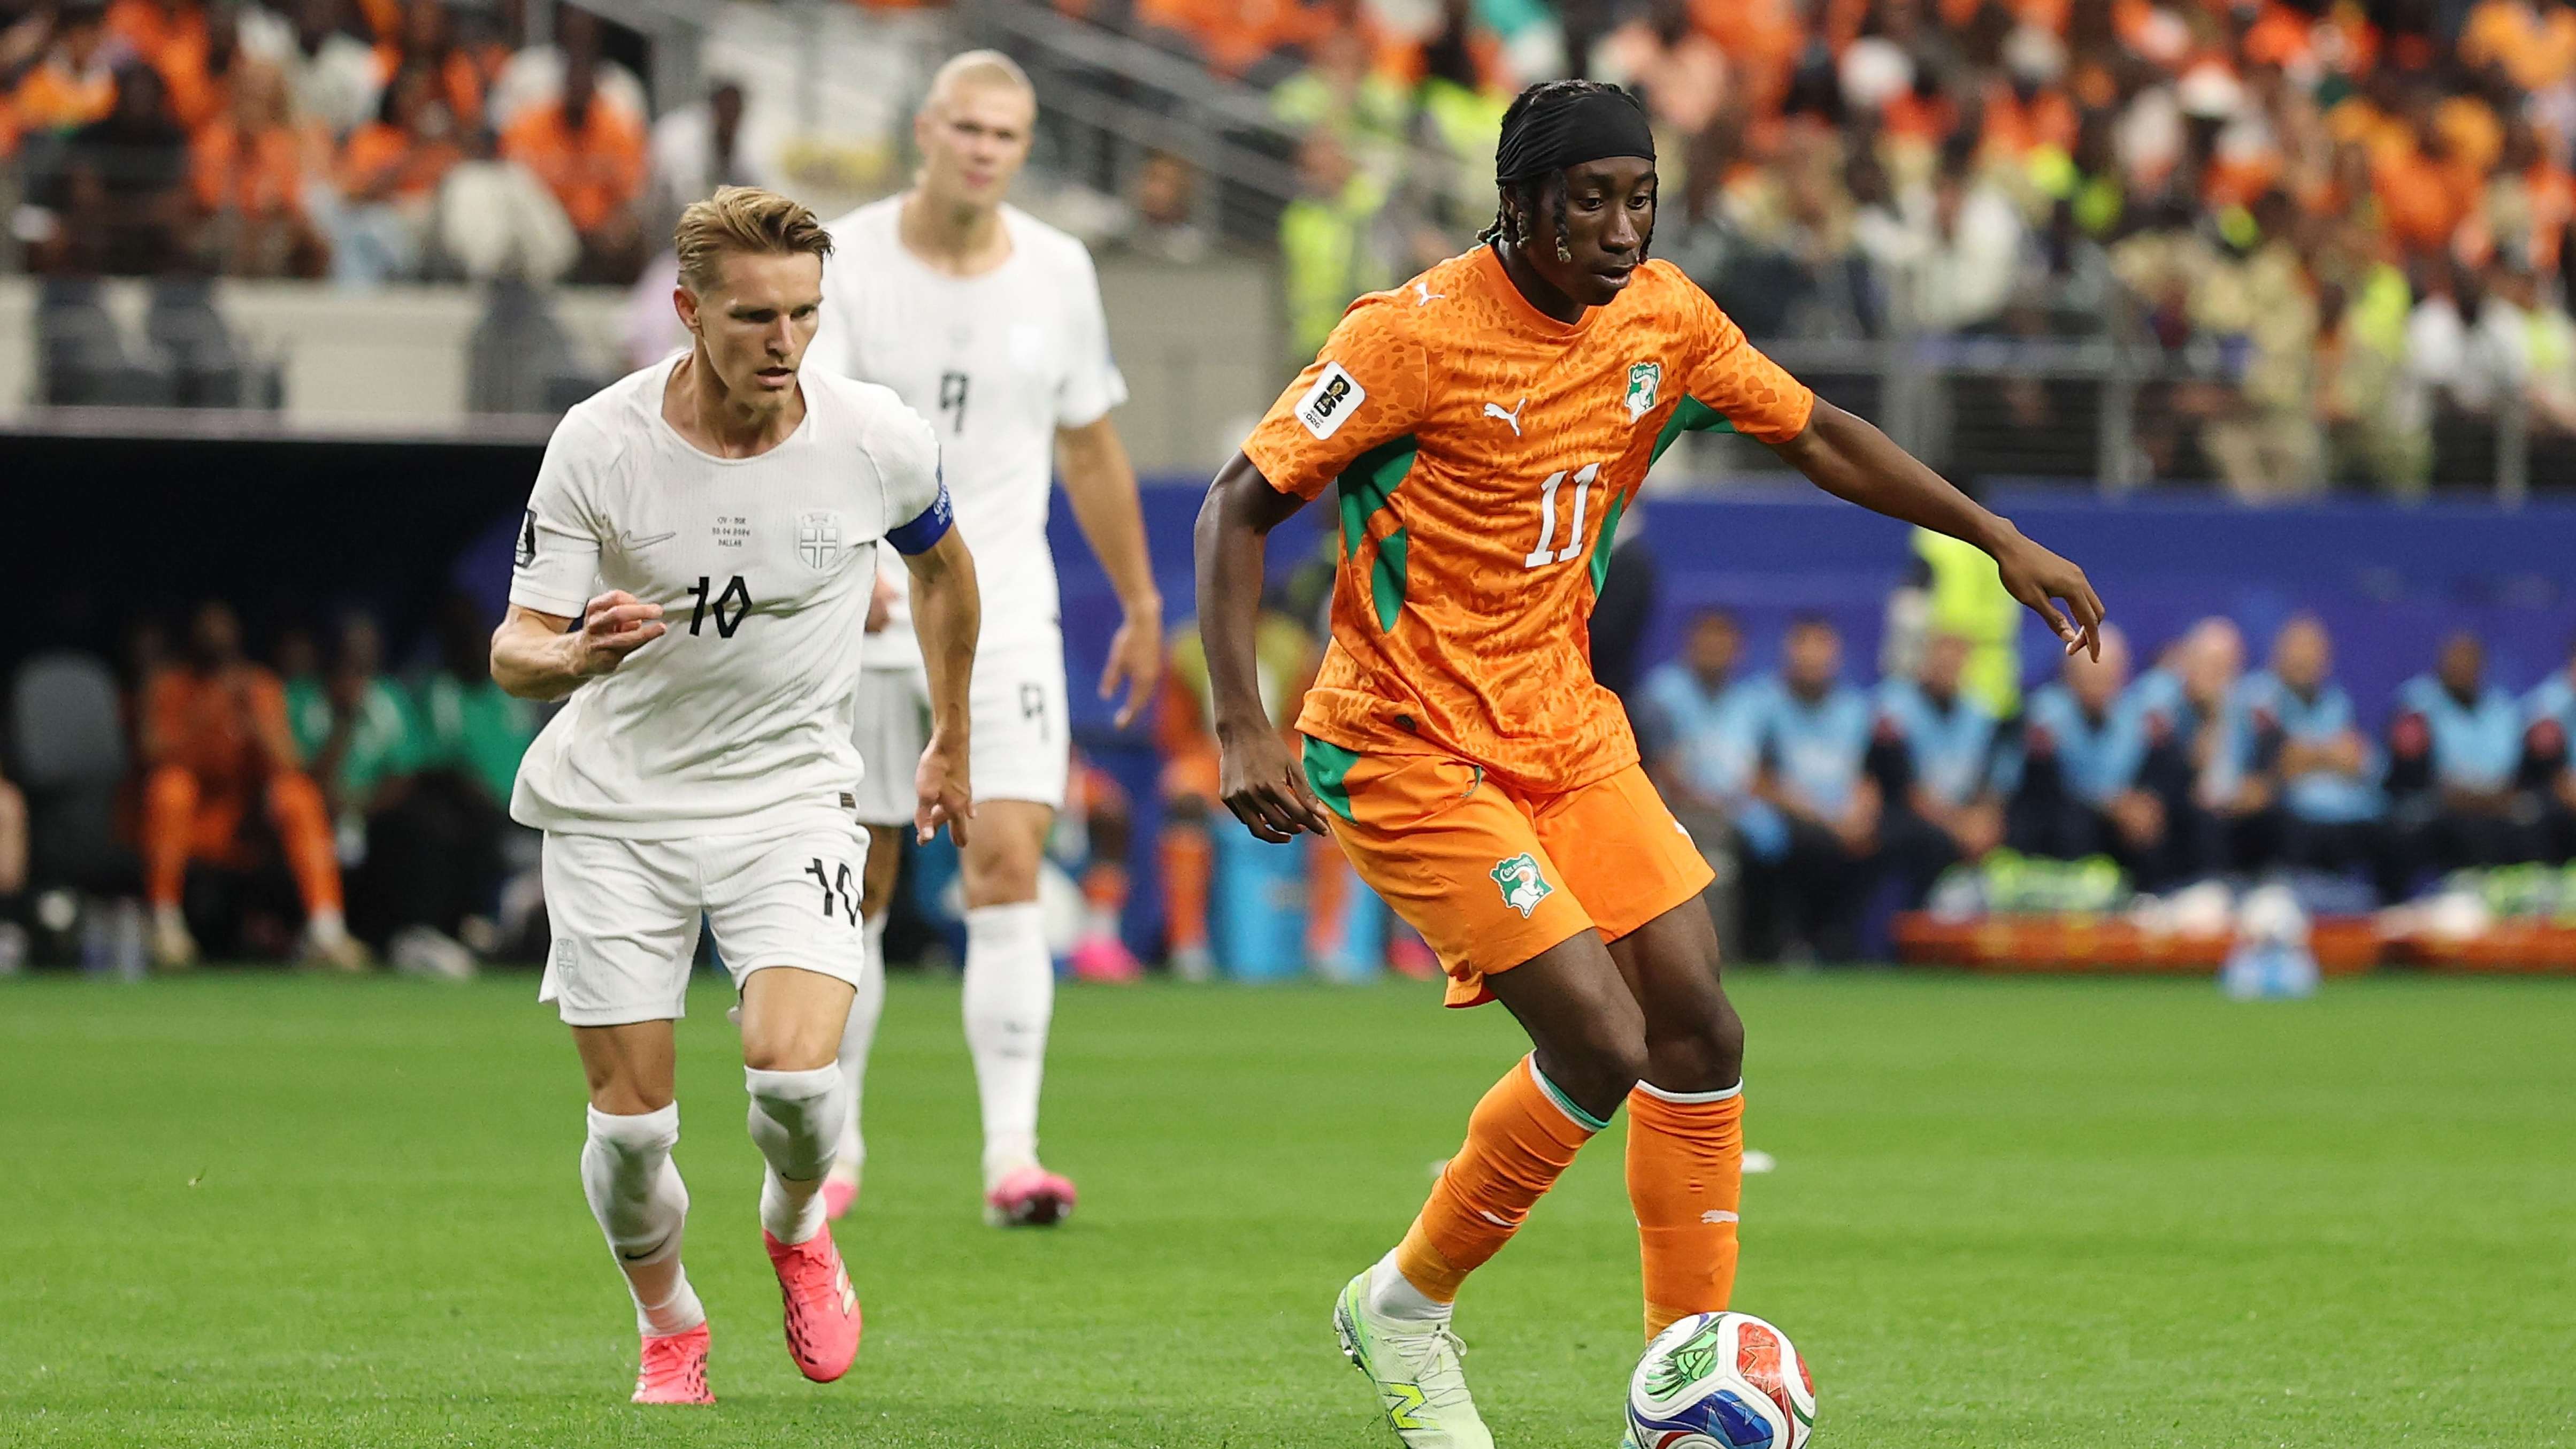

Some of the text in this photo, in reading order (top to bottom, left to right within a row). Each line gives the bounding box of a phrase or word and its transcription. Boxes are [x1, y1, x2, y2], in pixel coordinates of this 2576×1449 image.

[940, 372, 967, 433] 9
[1525, 462, 1601, 568] 11
[687, 575, 753, 638] 10
[1019, 683, 1051, 743] 9
[804, 857, 861, 927] 10
